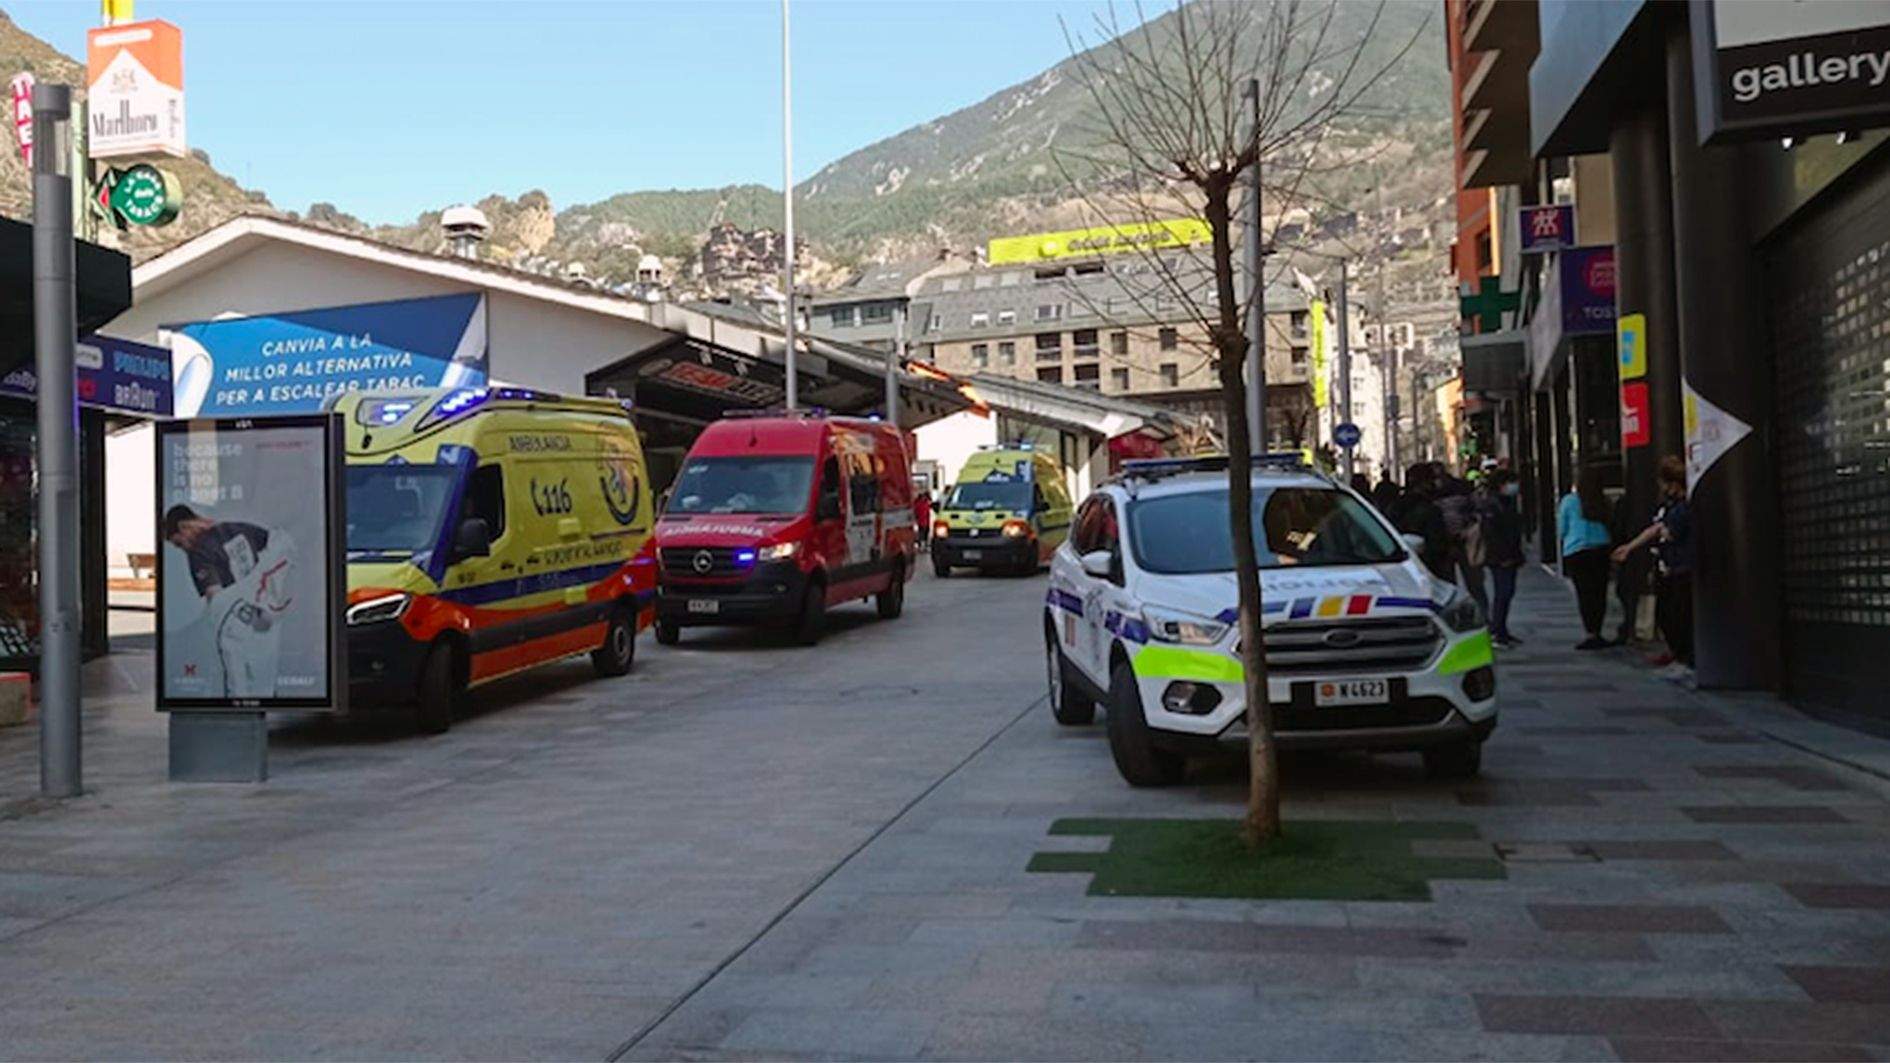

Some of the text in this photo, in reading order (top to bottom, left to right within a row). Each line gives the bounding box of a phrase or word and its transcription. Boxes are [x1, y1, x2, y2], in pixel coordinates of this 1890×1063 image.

[1732, 51, 1890, 101] gallery
[92, 98, 158, 137] Marlboro
[262, 332, 373, 356] CANVIA A LA
[225, 351, 412, 382] MILLOR ALTERNATIVA
[115, 381, 157, 409] BRAUN
[216, 389, 247, 405] PER
[252, 388, 265, 403] A
[366, 374, 426, 390] TABAC
[542, 478, 573, 514] 116
